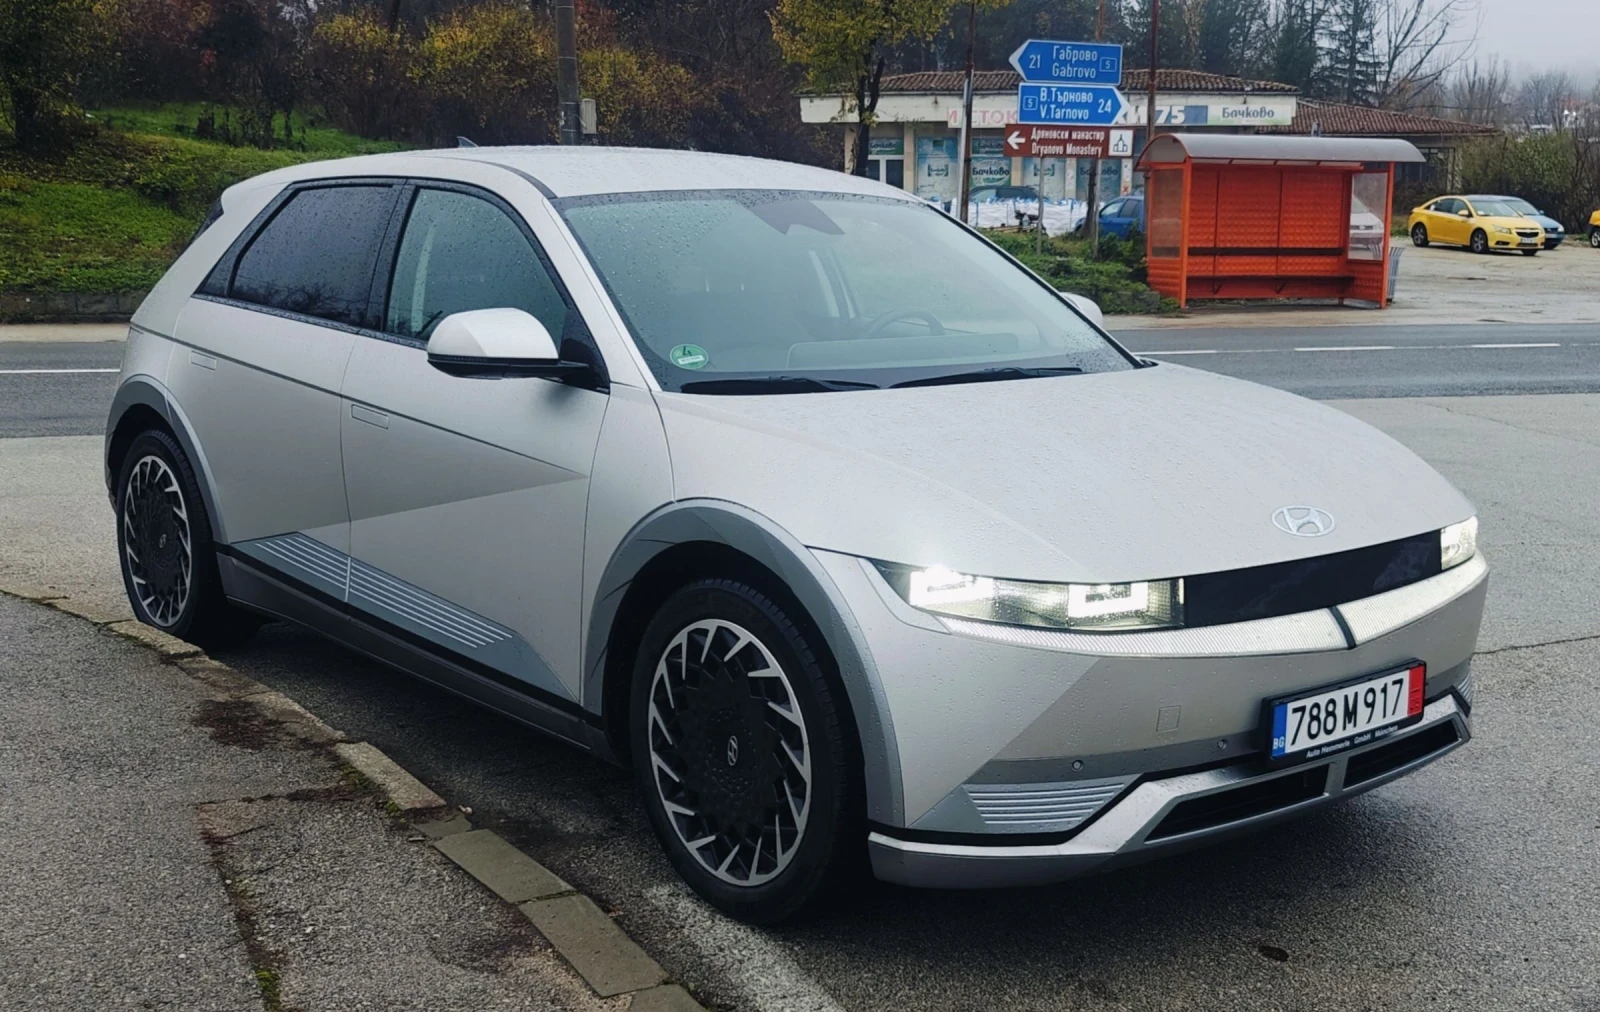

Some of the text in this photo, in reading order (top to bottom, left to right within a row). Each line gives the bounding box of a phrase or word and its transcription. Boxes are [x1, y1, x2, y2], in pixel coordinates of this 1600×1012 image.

[1029, 54, 1041, 69] 21
[1052, 45, 1098, 64] Габрово
[1052, 63, 1096, 79] Gabrovo
[1105, 61, 1111, 69] 5
[1027, 99, 1033, 107] 5
[1040, 87, 1093, 106] В.Търново
[1040, 104, 1089, 120] V.Tarnovo
[1097, 99, 1112, 114] 24
[1221, 106, 1275, 119] Бачково
[1155, 105, 1185, 125] 75
[1031, 127, 1105, 142] Дряновски манастир
[1031, 143, 1102, 158] Dryanovo Monastery
[972, 166, 1010, 177] Бачково
[1272, 736, 1285, 750] BG
[1306, 749, 1321, 759] Auto
[1354, 733, 1371, 744] GmbH
[1374, 725, 1399, 738] München
